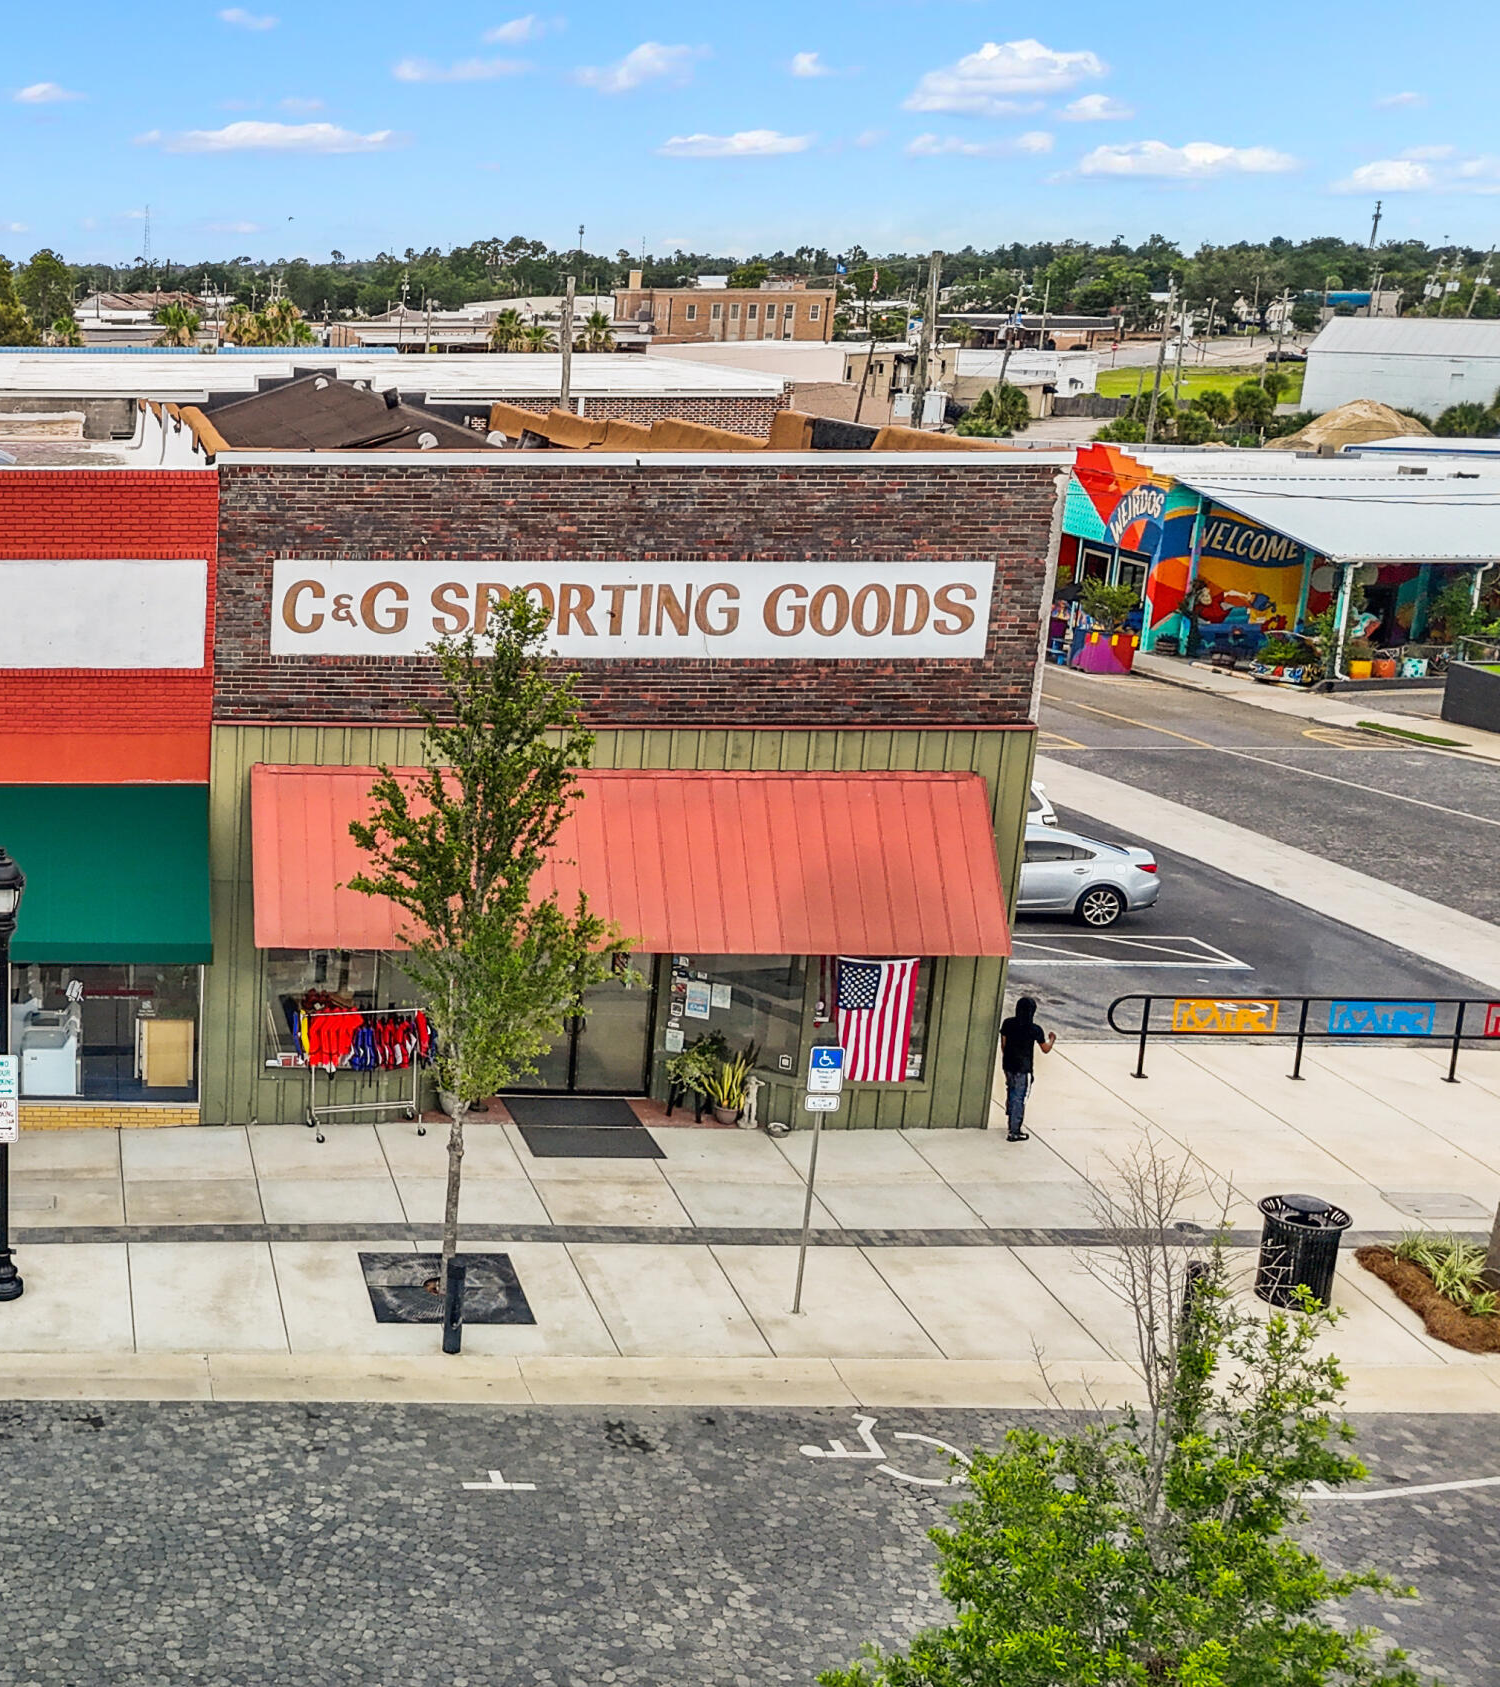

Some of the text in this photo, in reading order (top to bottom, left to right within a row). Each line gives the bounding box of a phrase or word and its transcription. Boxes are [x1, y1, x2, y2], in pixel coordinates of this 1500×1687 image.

[1110, 488, 1165, 543] WEIRDOS
[282, 579, 977, 636] C&G SPORTING GOODS
